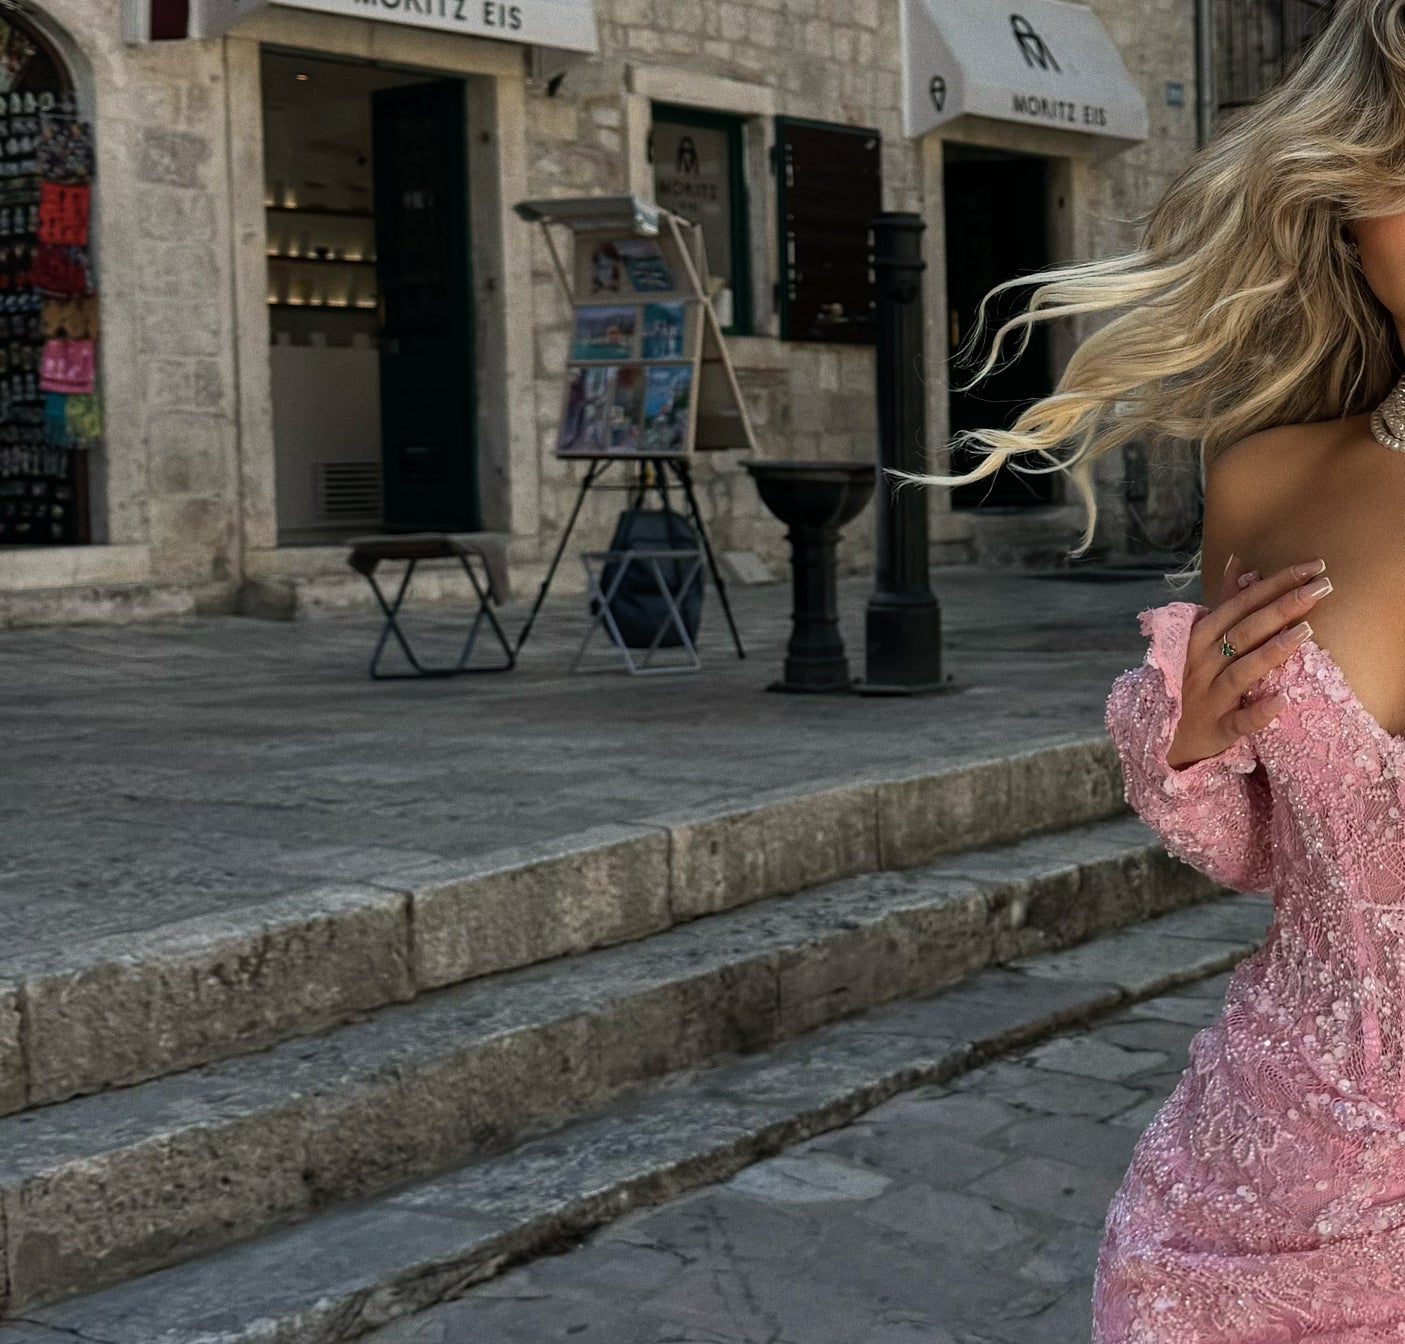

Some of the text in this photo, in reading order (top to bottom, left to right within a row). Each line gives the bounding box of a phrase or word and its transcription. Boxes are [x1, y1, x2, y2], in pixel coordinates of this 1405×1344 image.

[483, 1, 523, 30] EIS
[1012, 94, 1107, 127] MORITZ EIS
